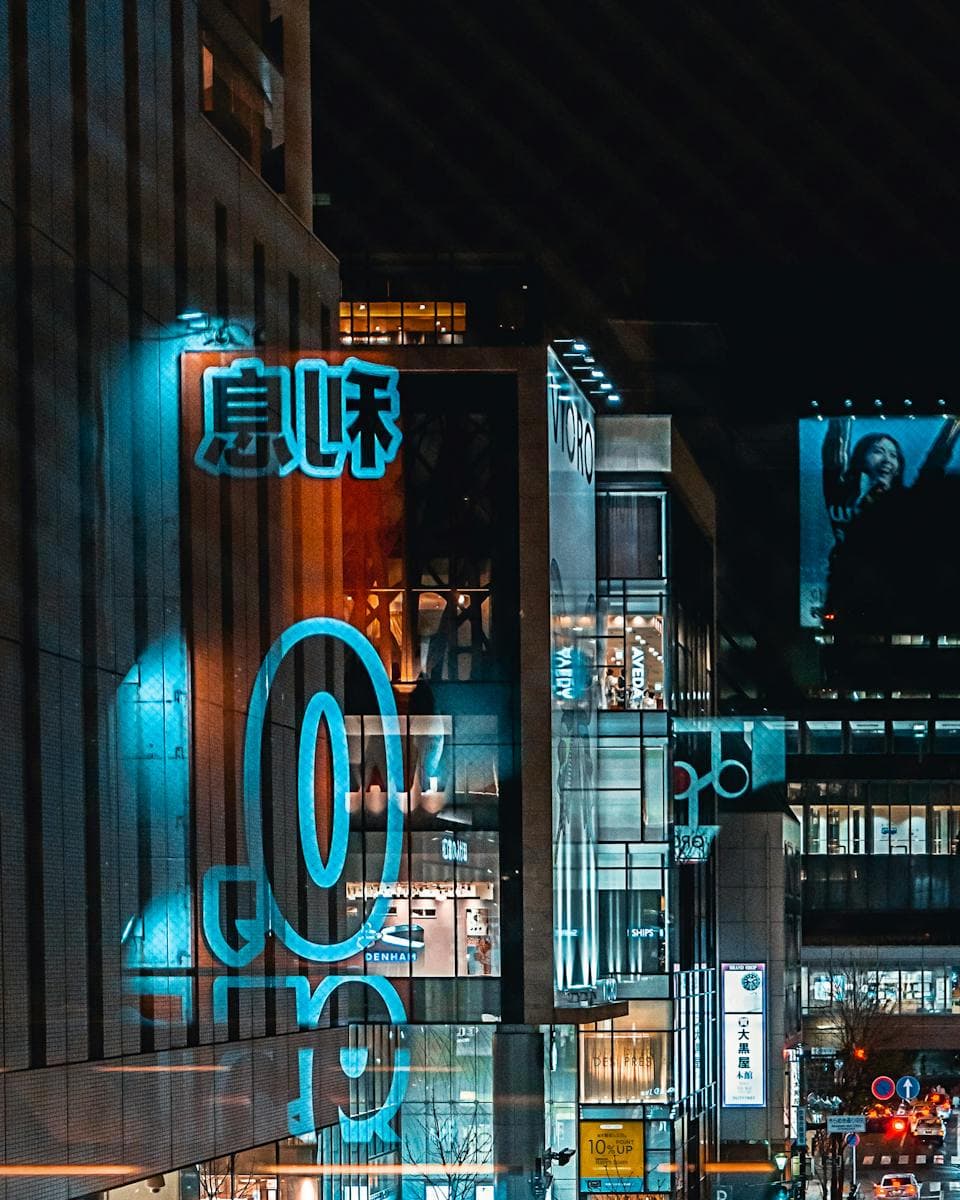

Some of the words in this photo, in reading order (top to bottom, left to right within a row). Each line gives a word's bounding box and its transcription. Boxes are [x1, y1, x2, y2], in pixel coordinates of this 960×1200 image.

[631, 928, 655, 938] SHIPS
[365, 952, 417, 962] DENHAM
[738, 1028, 751, 1069] 大黒屋
